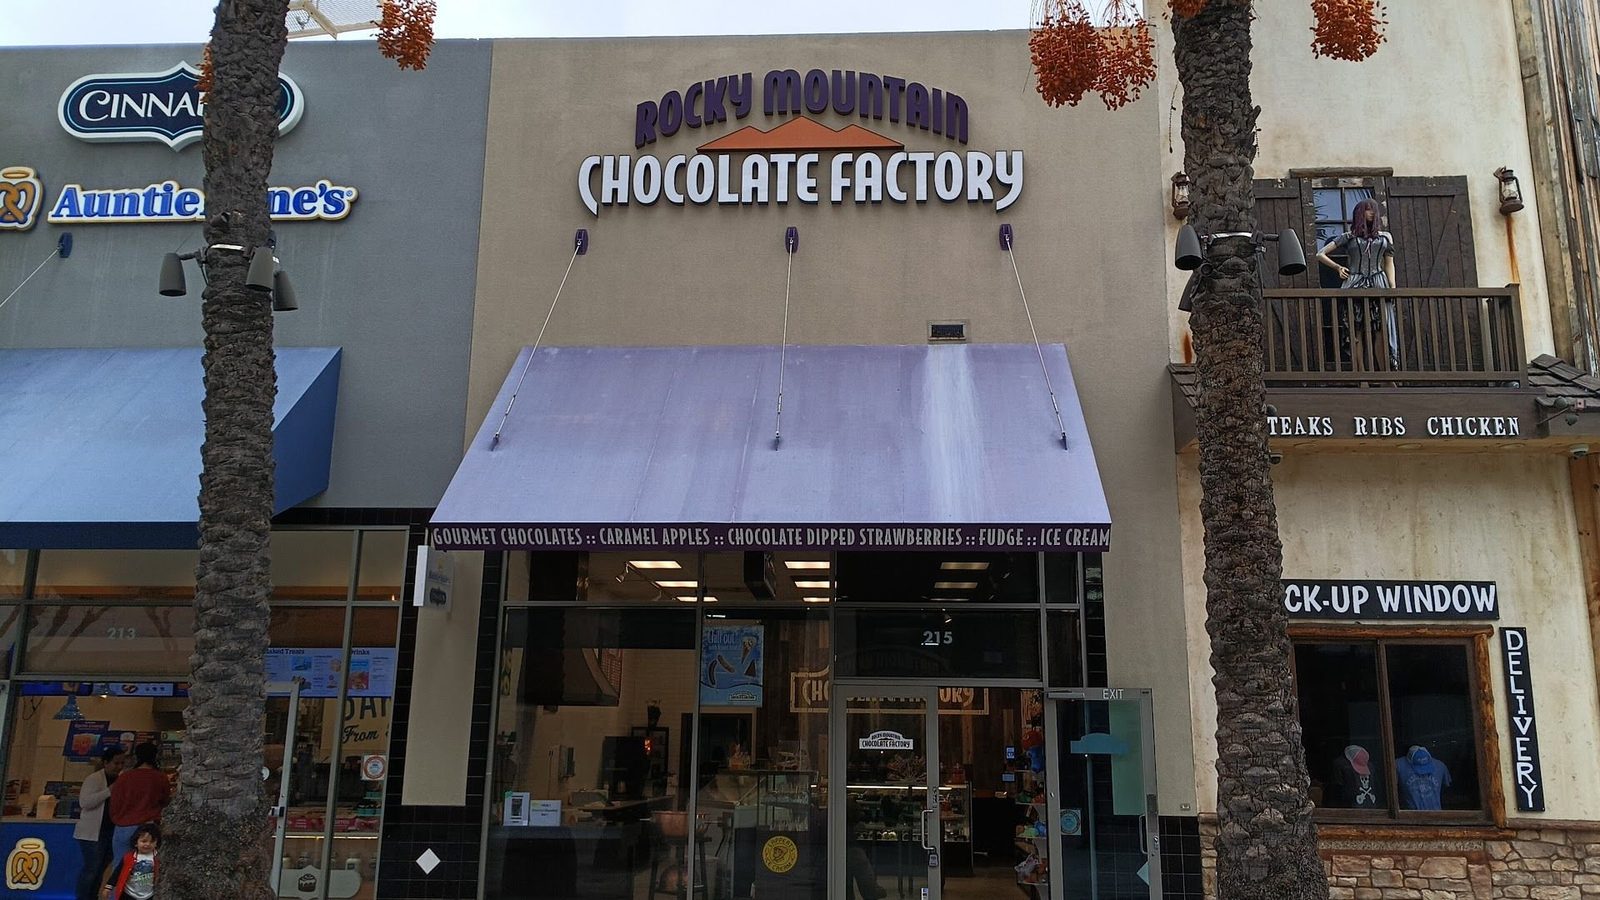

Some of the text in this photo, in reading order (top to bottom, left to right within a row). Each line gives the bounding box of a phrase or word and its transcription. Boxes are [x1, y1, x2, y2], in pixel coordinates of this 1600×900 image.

[79, 90, 207, 121] CINNA
[635, 68, 969, 150] ROCKY MOUNTAIN
[578, 150, 1025, 217] CHOCOLATE FACTORY
[51, 183, 345, 218] Auntie ne's
[1267, 416, 1519, 436] TEAKS RIBS CHICKEN
[433, 527, 1110, 547] GOURMET CHOCOLATES CARAMEL APPLES CHOCOLATE DIPPED STRAWBERRIES FUDGE ICE CREAM
[1284, 584, 1496, 614] CK-UP WINDOW
[107, 627, 136, 640] 213
[922, 631, 953, 644] 215
[1102, 688, 1124, 700] EXIT
[1505, 630, 1537, 808] DELIVERY
[341, 724, 379, 744] From
